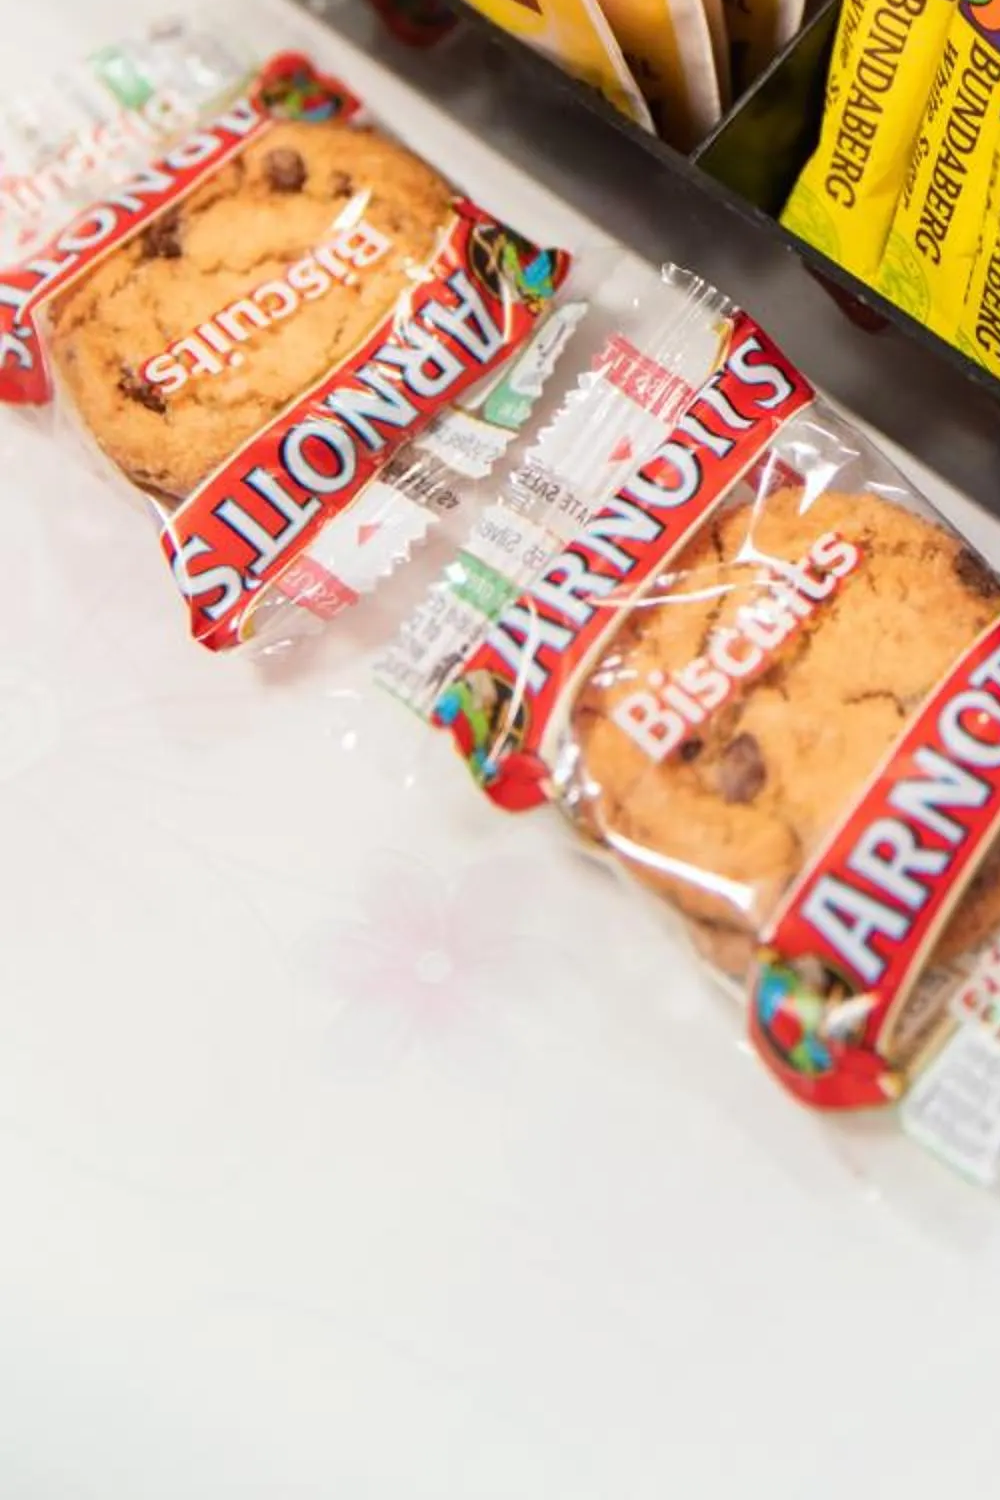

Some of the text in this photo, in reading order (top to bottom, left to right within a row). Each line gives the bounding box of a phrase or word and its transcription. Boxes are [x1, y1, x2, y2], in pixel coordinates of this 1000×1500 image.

[927, 39, 960, 123] White
[144, 221, 392, 394] Biscuits
[487, 336, 797, 693] ARNOTTS
[613, 533, 862, 761] Biscuits
